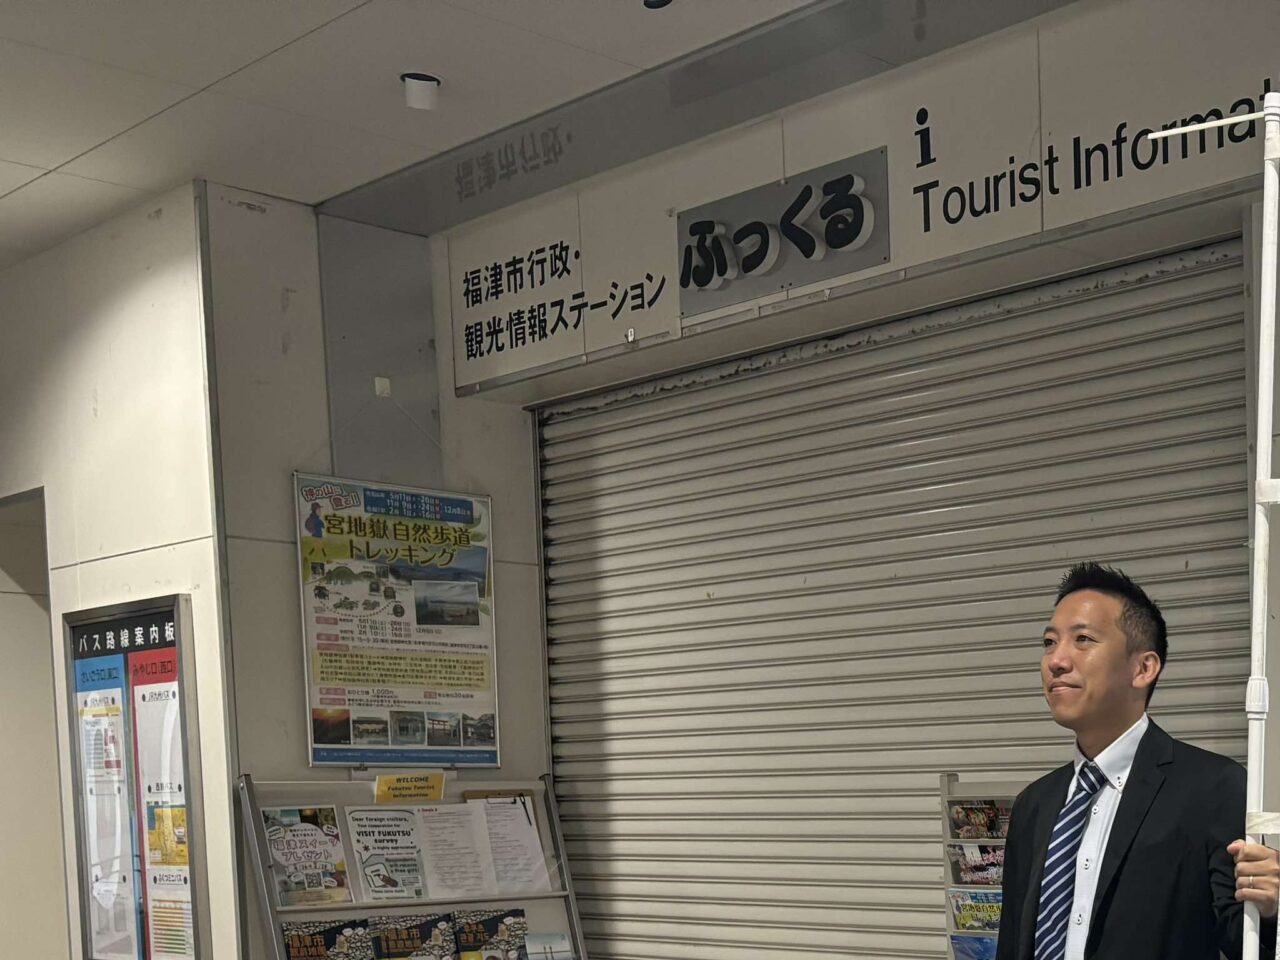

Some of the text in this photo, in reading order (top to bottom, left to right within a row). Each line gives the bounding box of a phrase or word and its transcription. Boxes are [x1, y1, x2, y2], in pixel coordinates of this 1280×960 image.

[913, 143, 1059, 233] Tourist
[680, 173, 870, 290] ふっくる
[463, 241, 581, 308] 福津市行政・
[464, 272, 666, 361] 観光情報ステーション
[324, 513, 472, 547] 宮地嶽自然歩道
[349, 539, 456, 568] トレッキング
[79, 622, 175, 652] バス路線案内板
[356, 830, 411, 838] VISIT FUKUTSU
